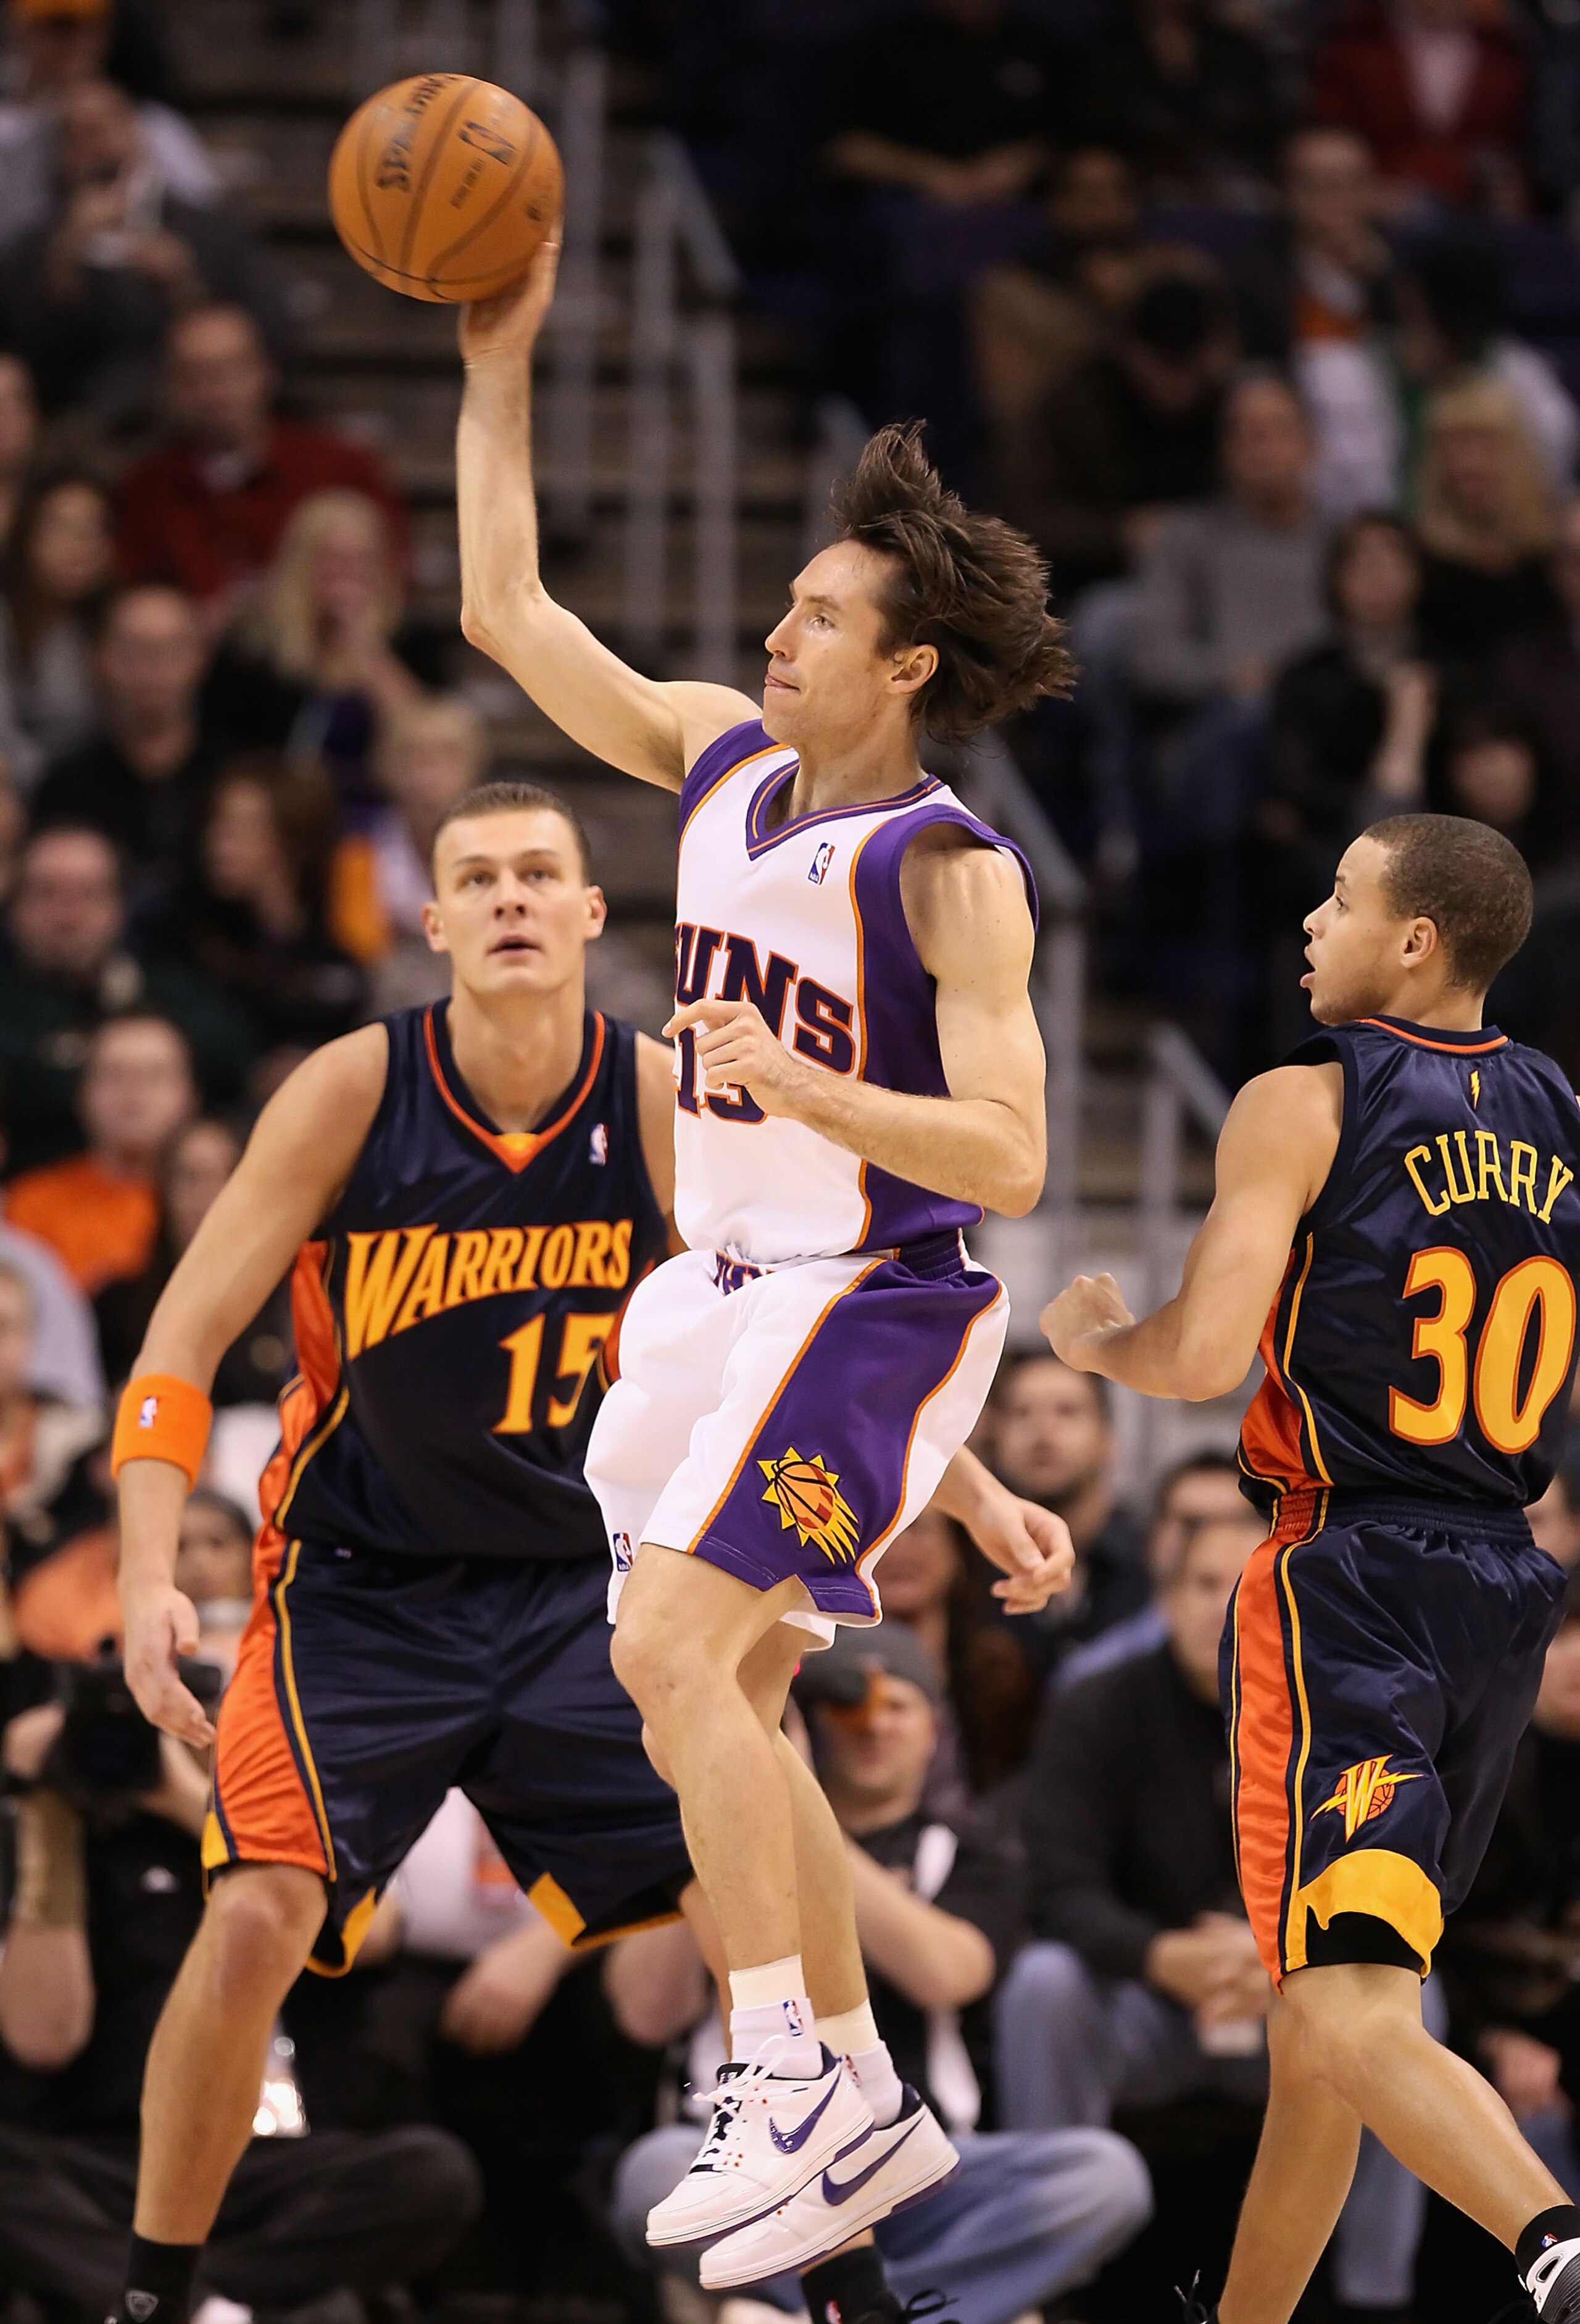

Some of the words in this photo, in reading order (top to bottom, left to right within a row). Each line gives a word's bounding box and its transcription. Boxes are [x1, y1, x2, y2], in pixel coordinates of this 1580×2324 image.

[675, 922, 857, 1075] UNS
[1404, 1130, 1574, 1224] CURRY
[344, 1218, 633, 1360] WARRIORS
[1389, 1246, 1576, 1454] 30
[489, 1310, 616, 1435] 15
